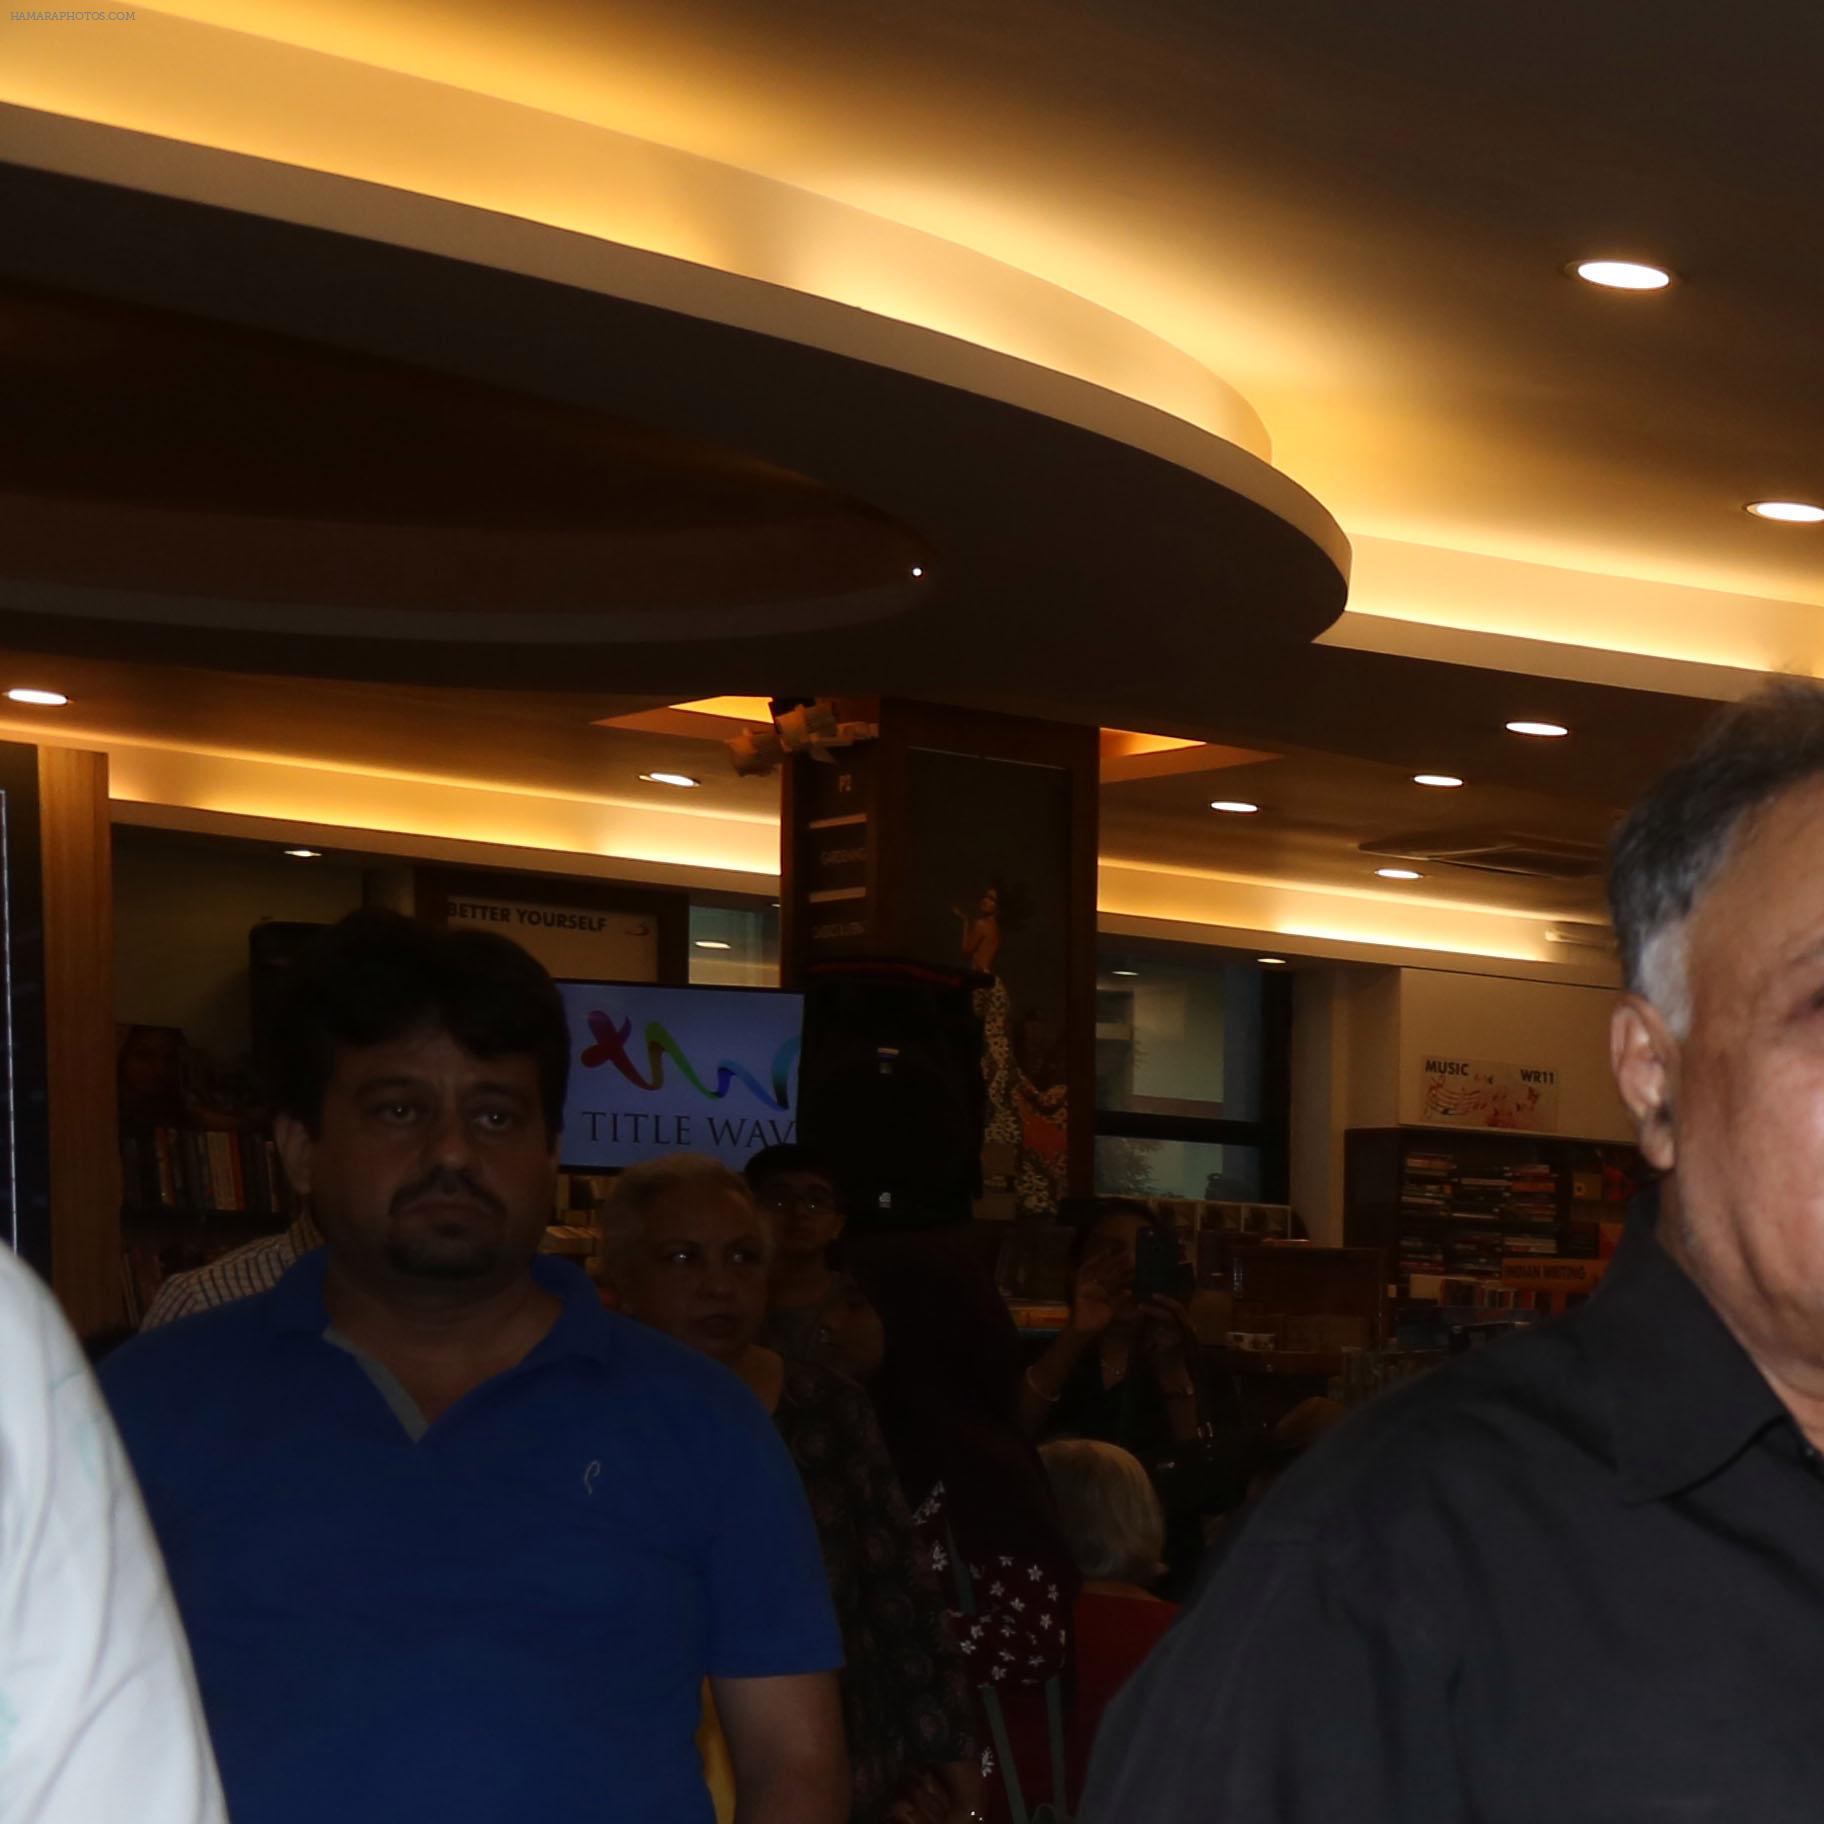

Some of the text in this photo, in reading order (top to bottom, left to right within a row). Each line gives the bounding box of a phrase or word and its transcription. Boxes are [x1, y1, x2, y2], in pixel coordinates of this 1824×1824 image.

[448, 902, 606, 932] BETTER YOURSELF
[1425, 1060, 1469, 1076] MUSIC
[1521, 1069, 1555, 1084] WR11
[582, 1111, 690, 1146] TITLE
